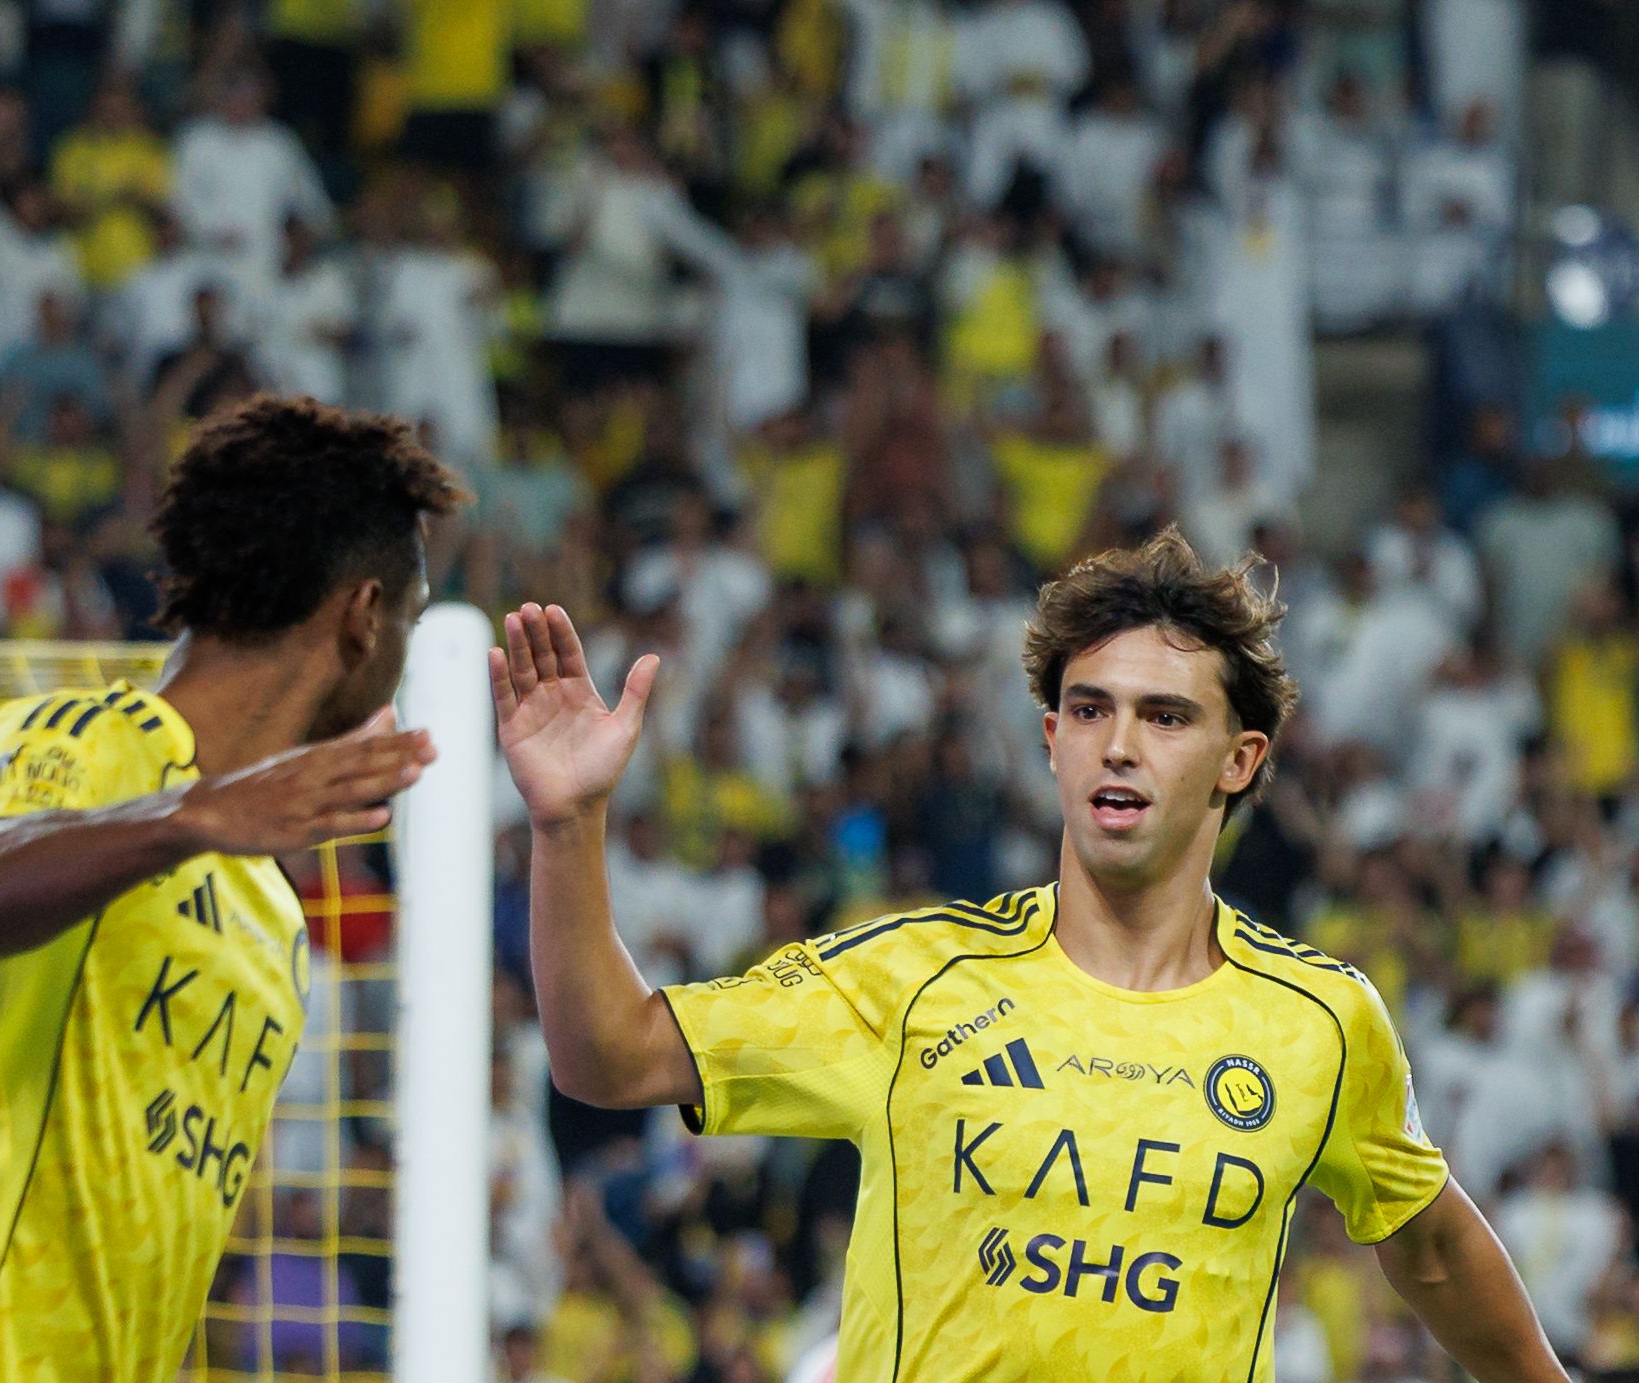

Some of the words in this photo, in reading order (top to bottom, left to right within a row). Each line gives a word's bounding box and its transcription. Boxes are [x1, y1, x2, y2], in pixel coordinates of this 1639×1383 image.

[134, 955, 284, 1094] KAF
[920, 997, 1016, 1070] Gathern
[1225, 1058, 1261, 1076] NASSR
[176, 1104, 250, 1208] SHG
[953, 1118, 1263, 1230] KAFD
[1020, 1232, 1184, 1313] SHG
